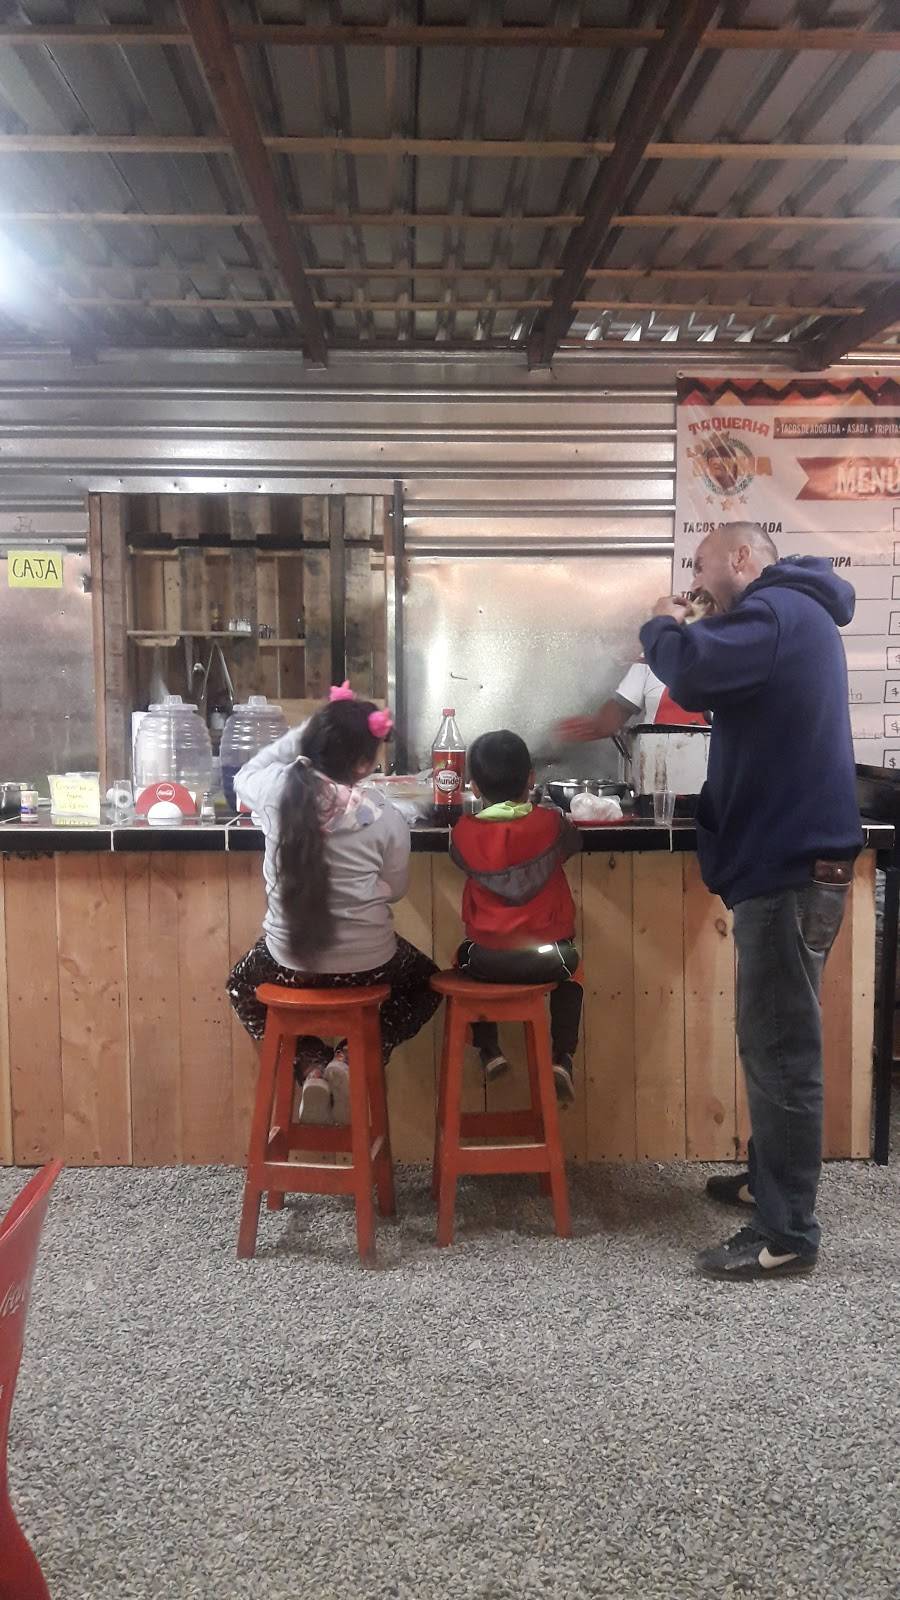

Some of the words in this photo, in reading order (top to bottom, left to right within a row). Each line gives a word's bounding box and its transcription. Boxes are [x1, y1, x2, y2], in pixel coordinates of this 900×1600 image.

[687, 417, 770, 437] TAQUERIA
[810, 423, 841, 434] ADOBADA
[847, 423, 868, 434] ASADA
[683, 522, 715, 533] TACOS
[12, 558, 58, 580] CAJA
